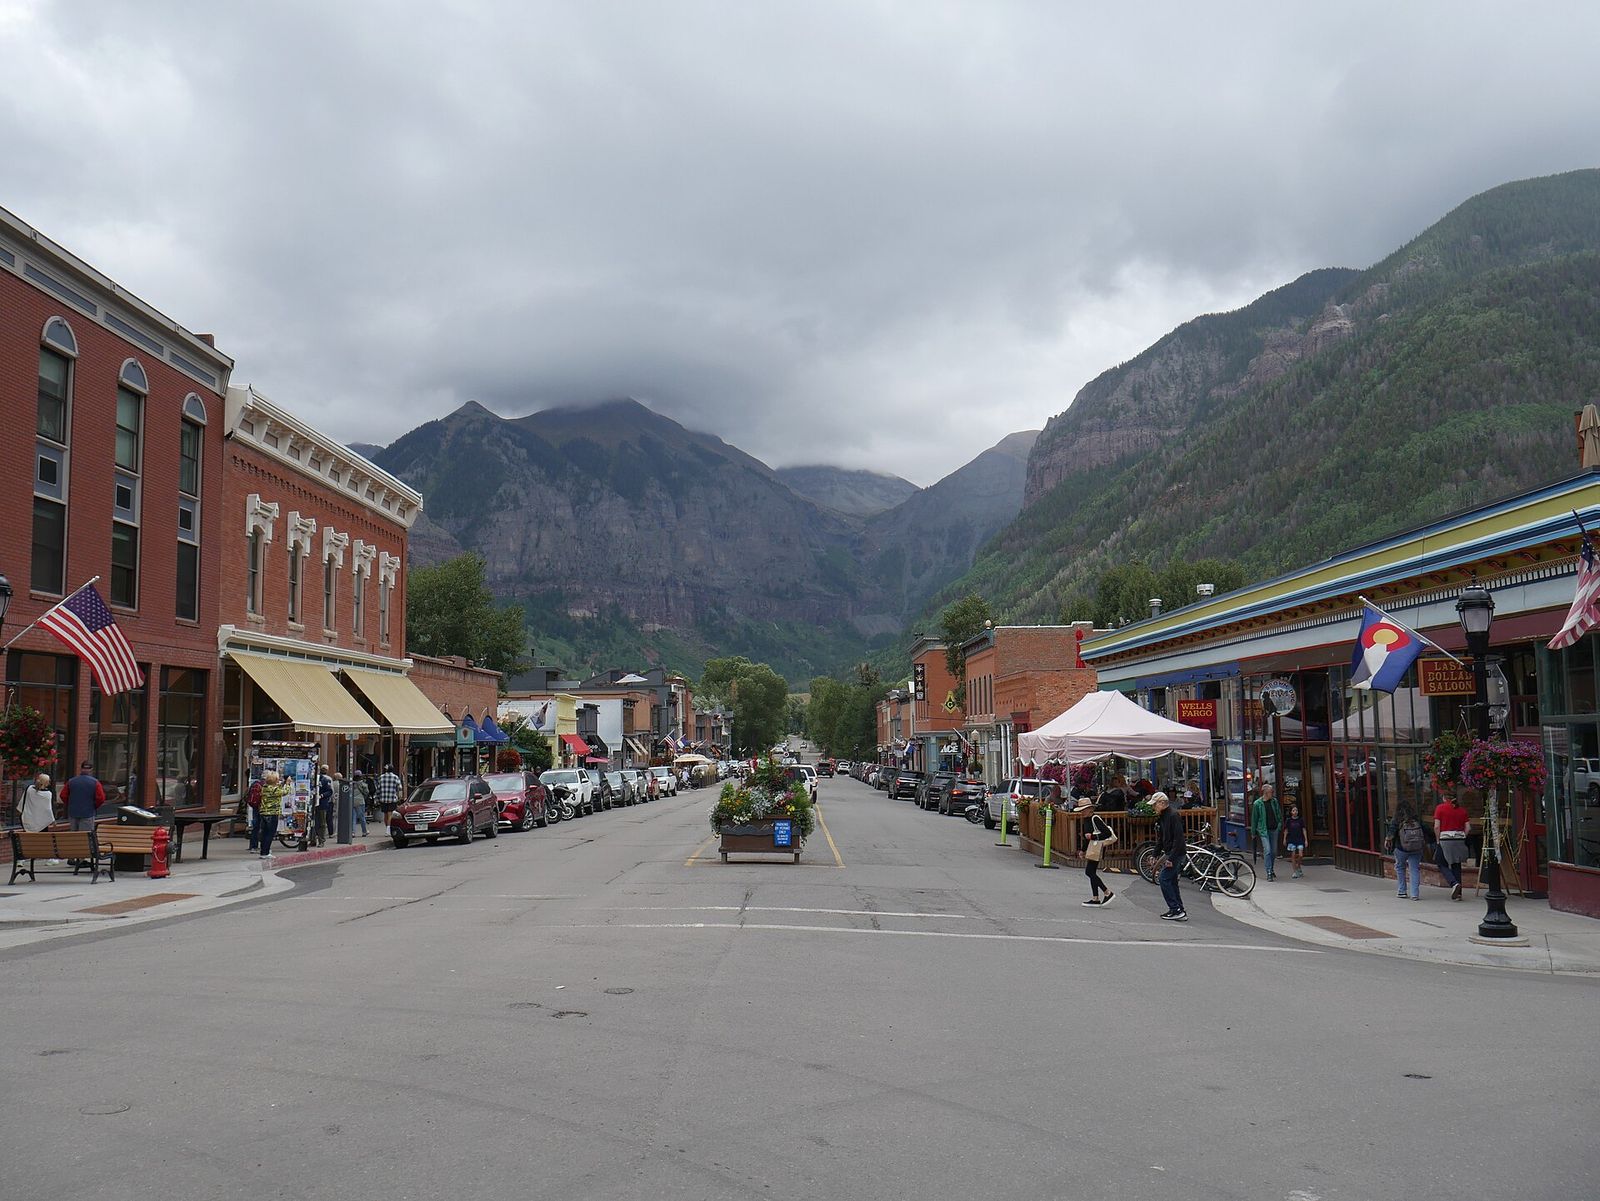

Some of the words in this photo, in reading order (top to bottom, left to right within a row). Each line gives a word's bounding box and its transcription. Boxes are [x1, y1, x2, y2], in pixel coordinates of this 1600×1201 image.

[1434, 661, 1463, 671] LAST
[1265, 680, 1288, 690] BROWN
[1429, 681, 1472, 692] SALOON
[1181, 702, 1213, 710] WELLS
[940, 743, 959, 753] ACE
